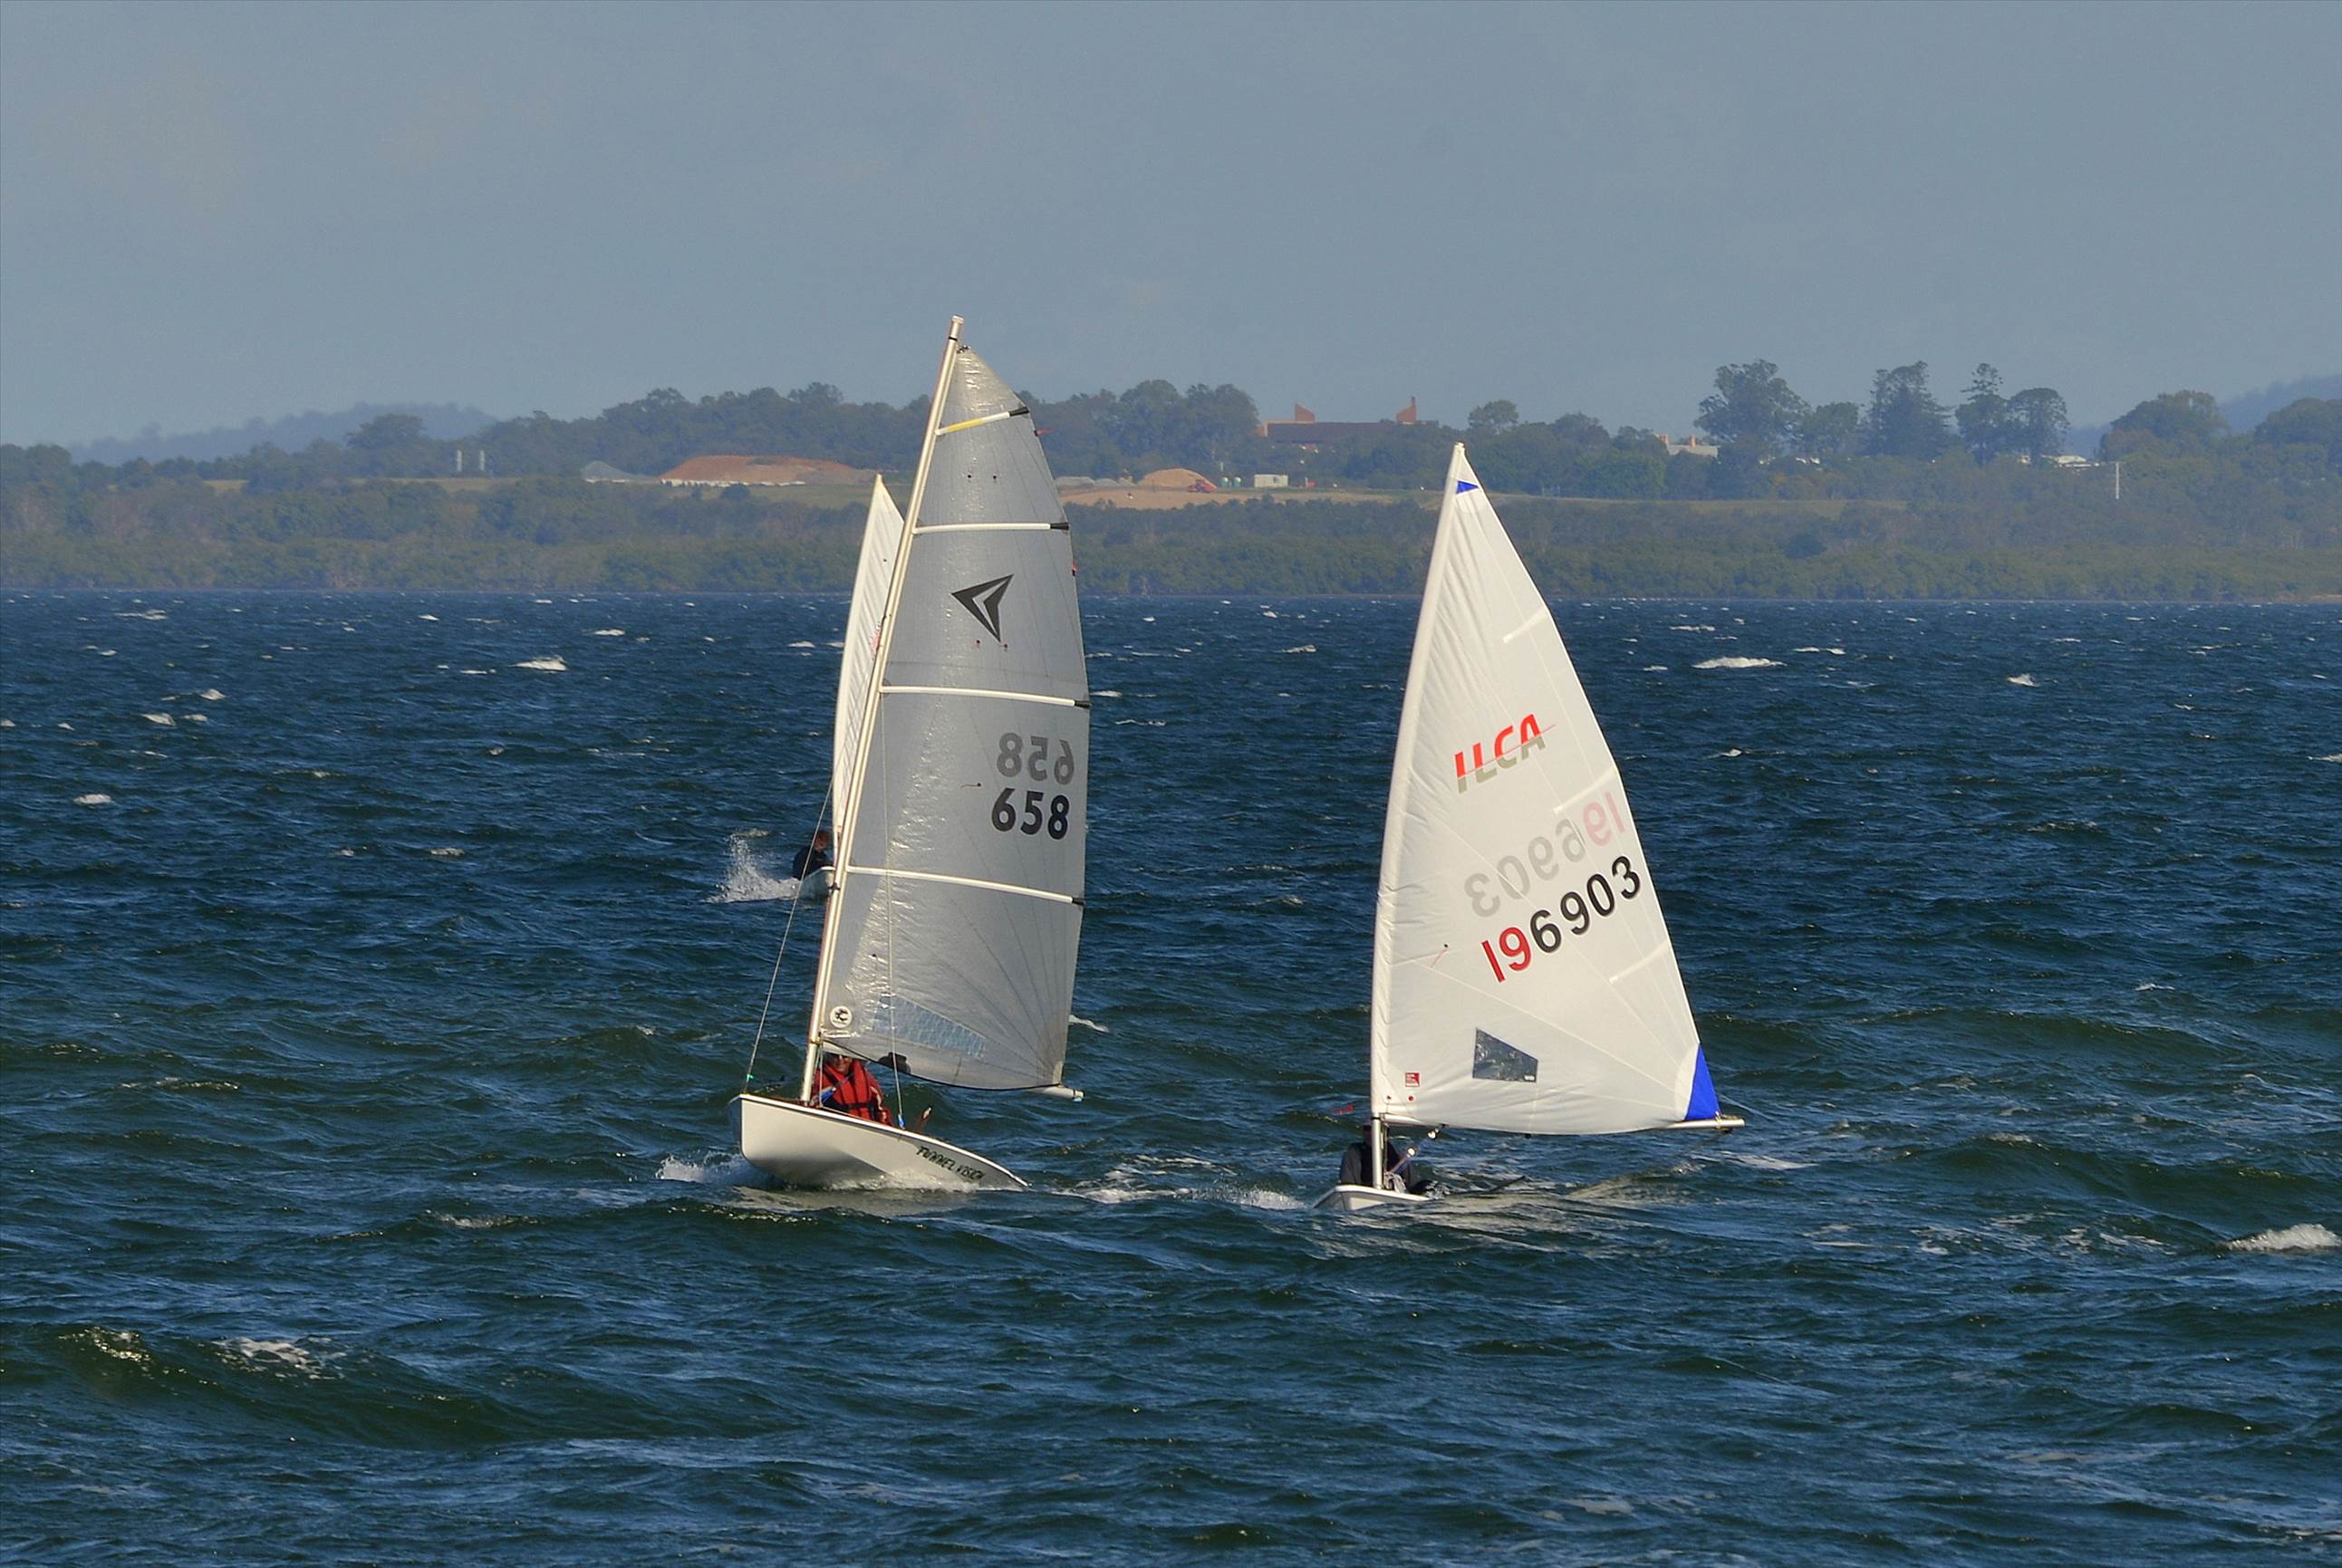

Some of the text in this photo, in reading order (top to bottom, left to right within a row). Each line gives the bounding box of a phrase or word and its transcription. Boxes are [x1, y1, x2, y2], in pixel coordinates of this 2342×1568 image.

[1454, 713, 1546, 794] ILCA
[991, 787, 1069, 840] 658
[1481, 856, 1641, 983] 196903
[916, 1145, 956, 1171] TUNNEL
